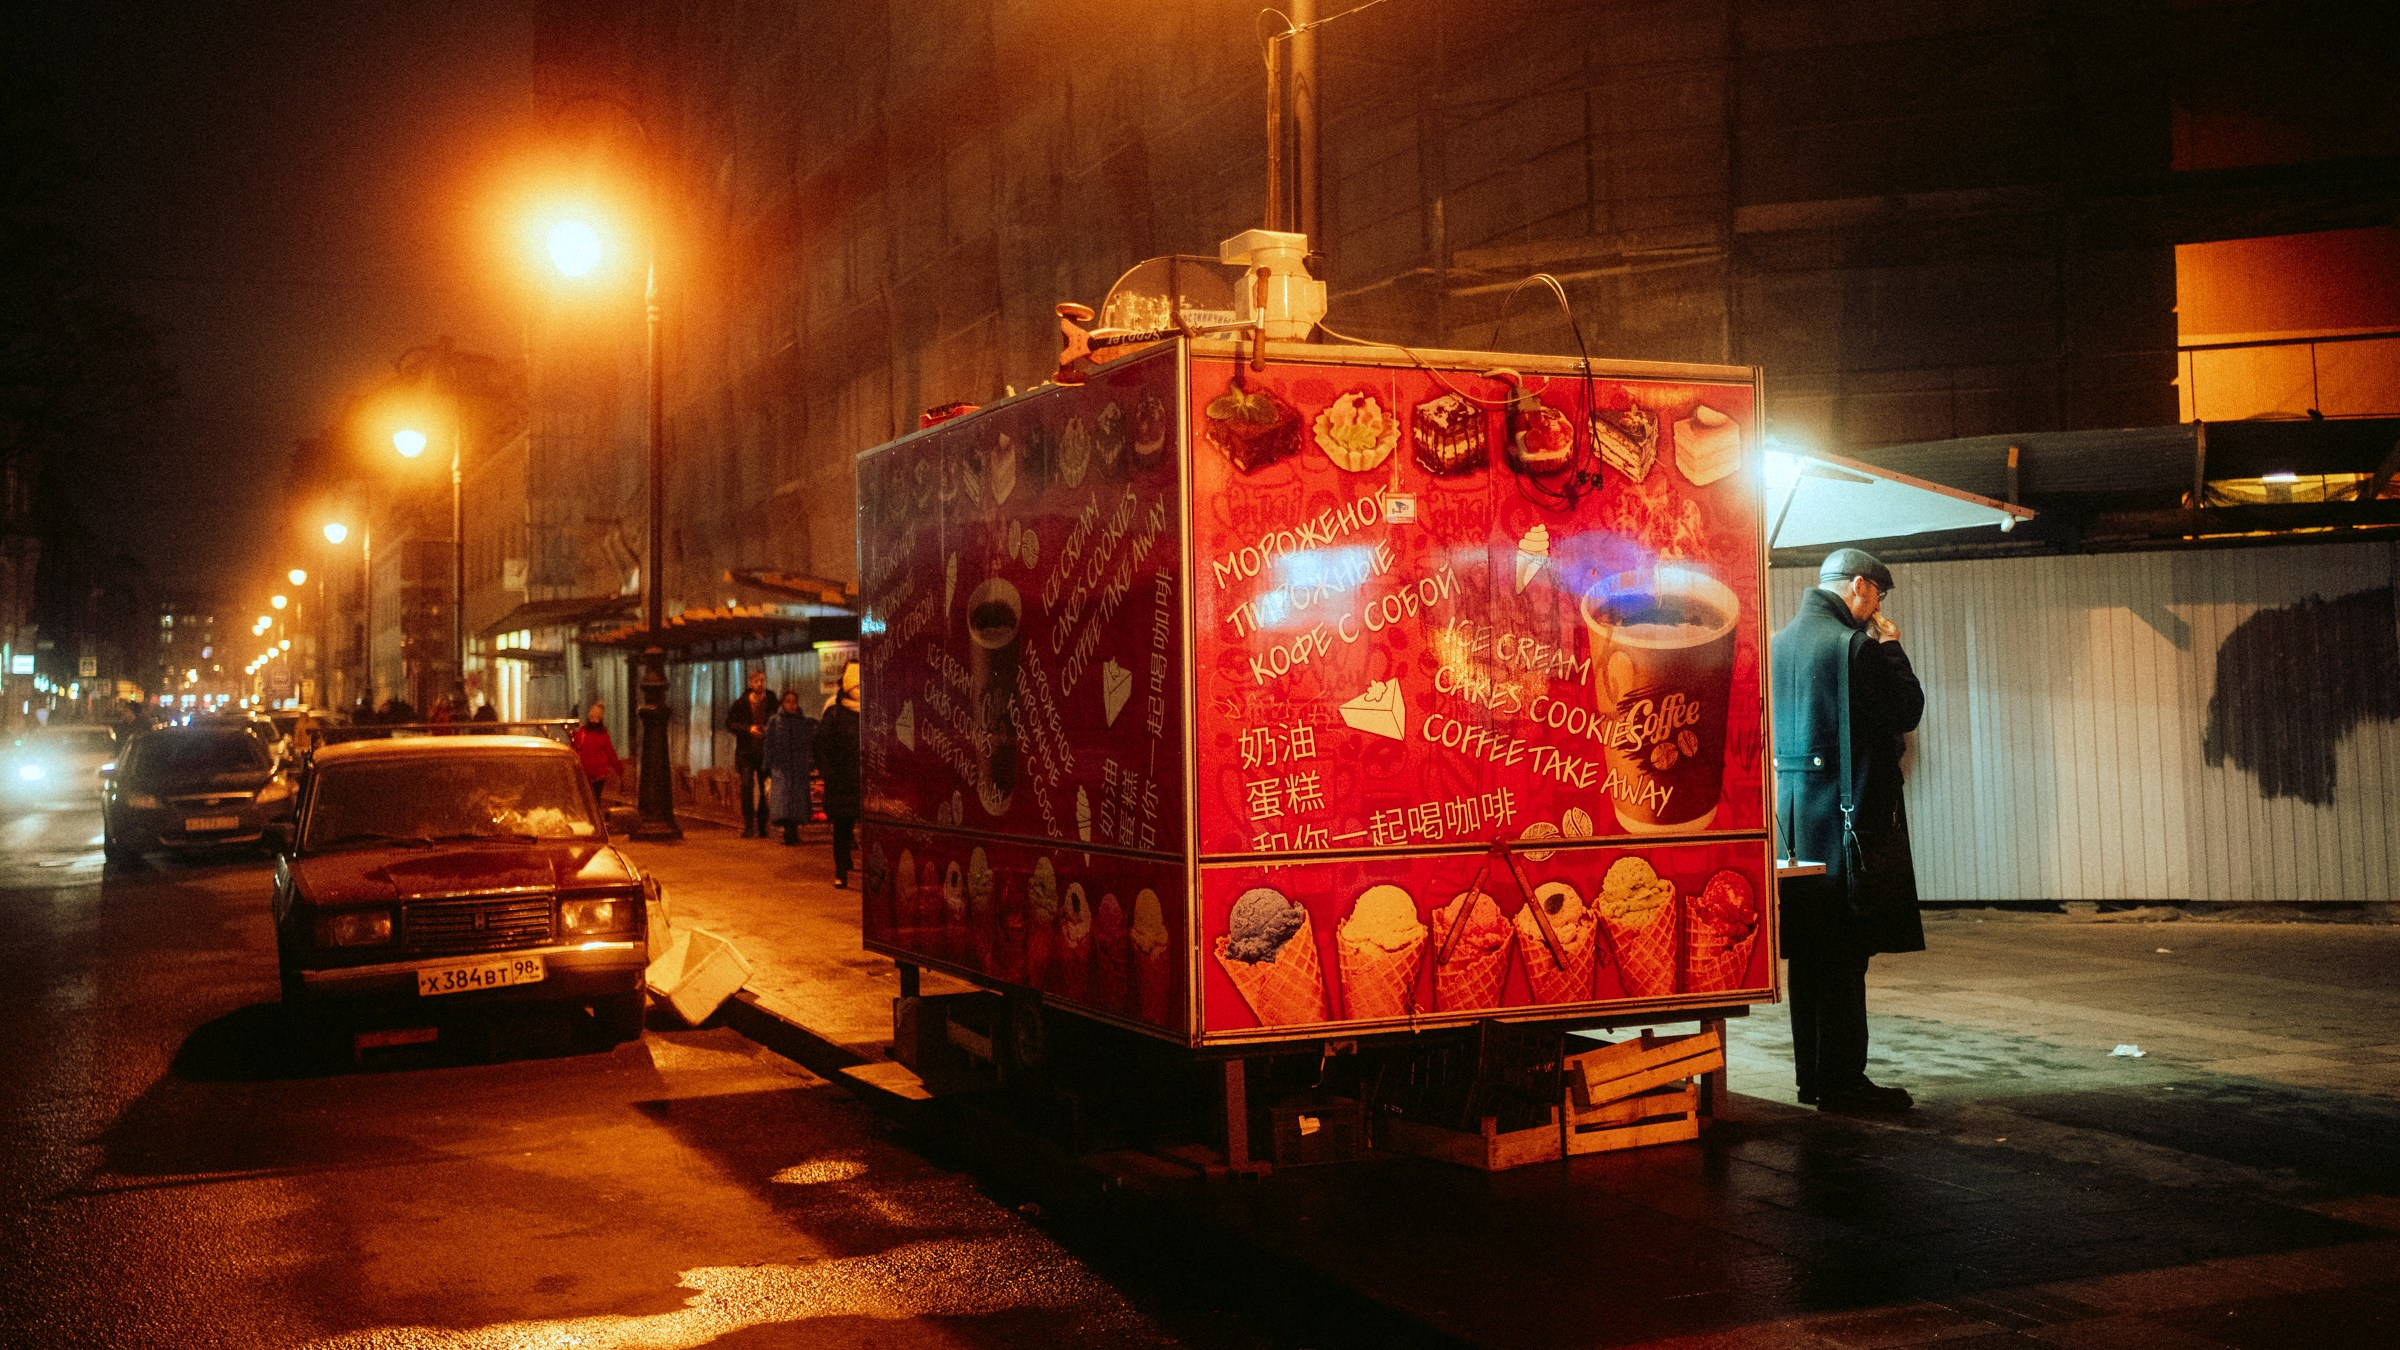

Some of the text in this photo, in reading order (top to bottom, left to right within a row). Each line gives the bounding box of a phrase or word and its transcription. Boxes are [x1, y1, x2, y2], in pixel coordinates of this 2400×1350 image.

[1042, 490, 1100, 616] ICE CREAM
[1052, 482, 1138, 655] CAKES COOKIES
[1061, 492, 1167, 697] COFFEE TAKE AWAY
[1249, 563, 1462, 685] КОФЕ С СОБОЙ
[1446, 616, 1592, 687] ICE CREAM
[927, 641, 975, 698] ICE CREAM
[1025, 639, 1076, 774] МОРОЖЕНОЕ
[1434, 665, 1644, 752] CAKES COOKIES
[924, 679, 952, 721] CAKES
[952, 705, 993, 758] COOKIES
[1007, 693, 1031, 754] КОФЕ
[1016, 665, 1061, 788] ПИРОЖНЫЕ
[1238, 719, 1317, 770] 奶油
[1625, 692, 1700, 745] Coffee
[921, 718, 954, 764] COFFEE
[953, 747, 978, 787] TAKE
[976, 771, 1005, 804] AWAY
[1100, 758, 1119, 839] 奶油
[1246, 769, 1325, 822] 蛋糕
[1422, 713, 1674, 817] COFFEE TAKE AWAY
[1118, 768, 1139, 847] 蛋糕
[1252, 786, 1518, 873] 和你一起喝咖啡
[514, 960, 534, 976] 98
